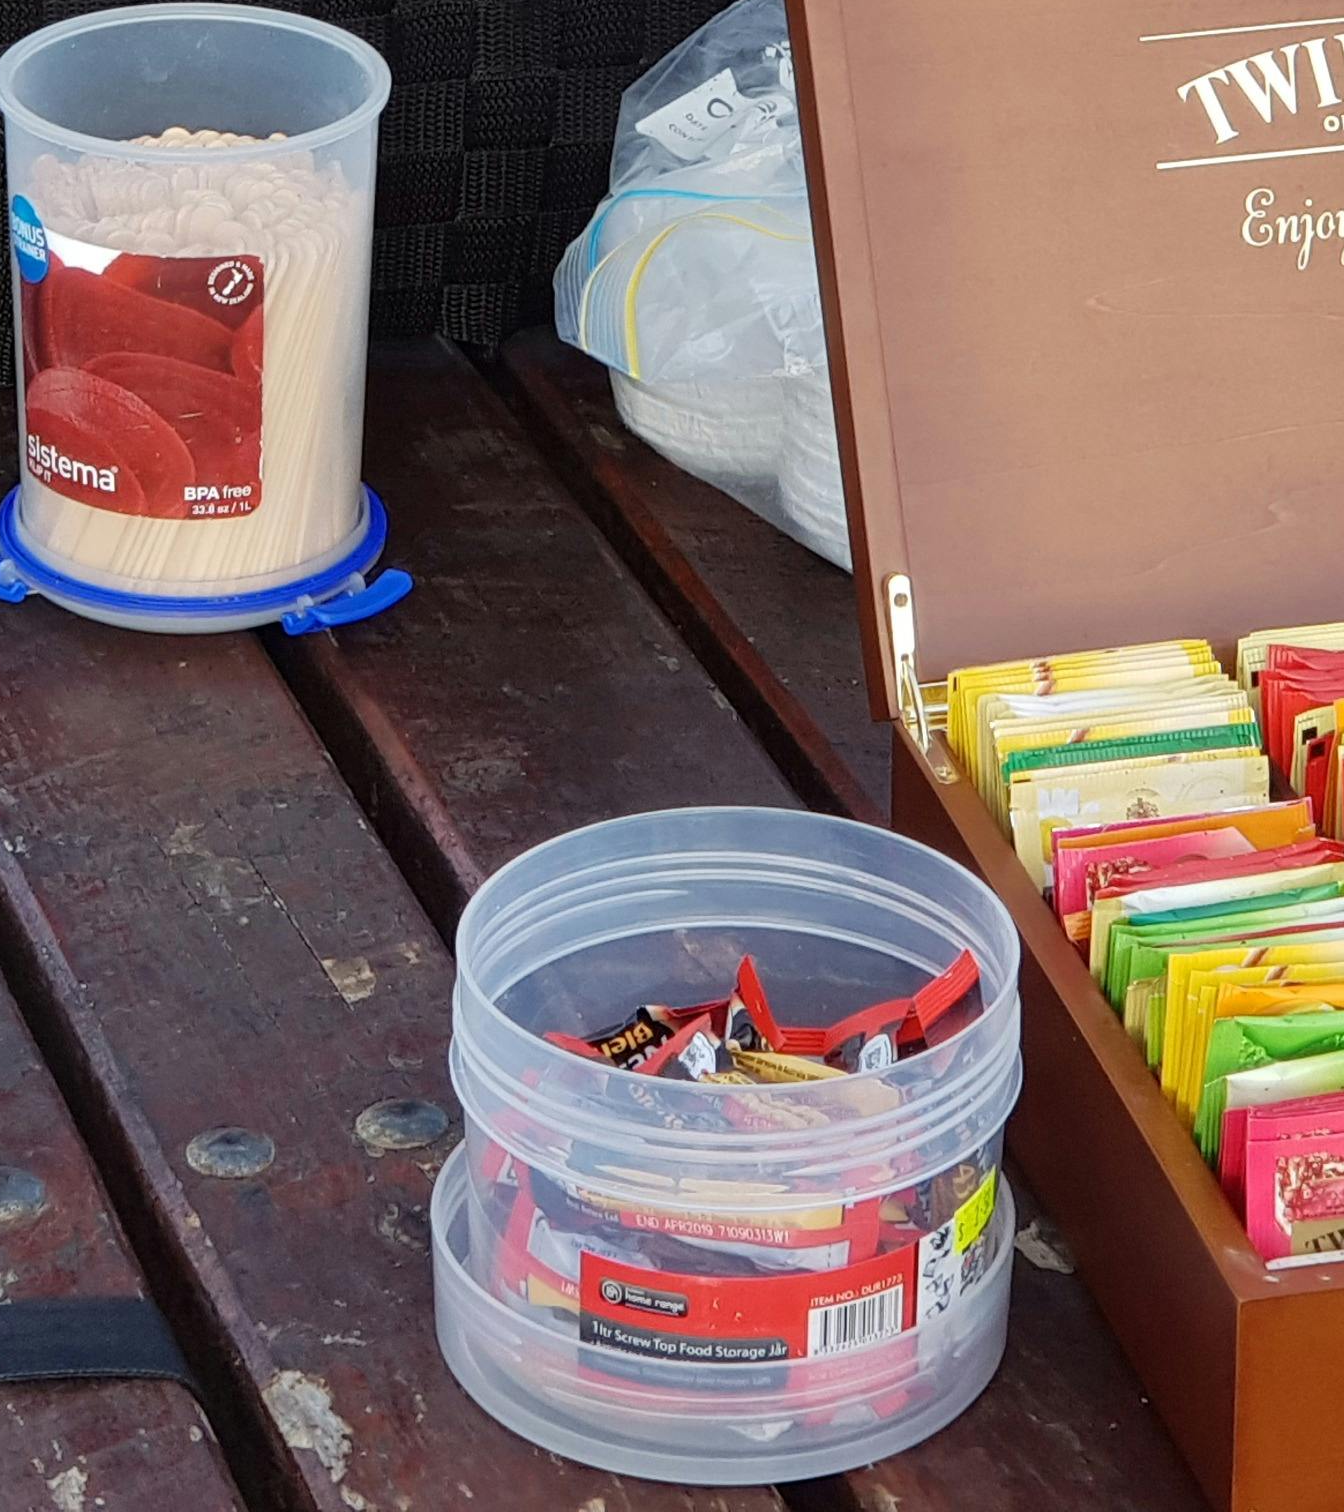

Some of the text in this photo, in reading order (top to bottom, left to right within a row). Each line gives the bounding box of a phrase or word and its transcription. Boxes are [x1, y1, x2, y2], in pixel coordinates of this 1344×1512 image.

[27, 434, 116, 492] sistema
[184, 484, 252, 501] BPA free
[636, 1214, 660, 1229] END
[664, 1218, 714, 1237] APR2019
[810, 1294, 835, 1308] ITEM
[614, 1328, 652, 1349] Screw
[653, 1337, 677, 1355] Top
[679, 1342, 713, 1357] Food
[715, 1345, 766, 1361] Storage
